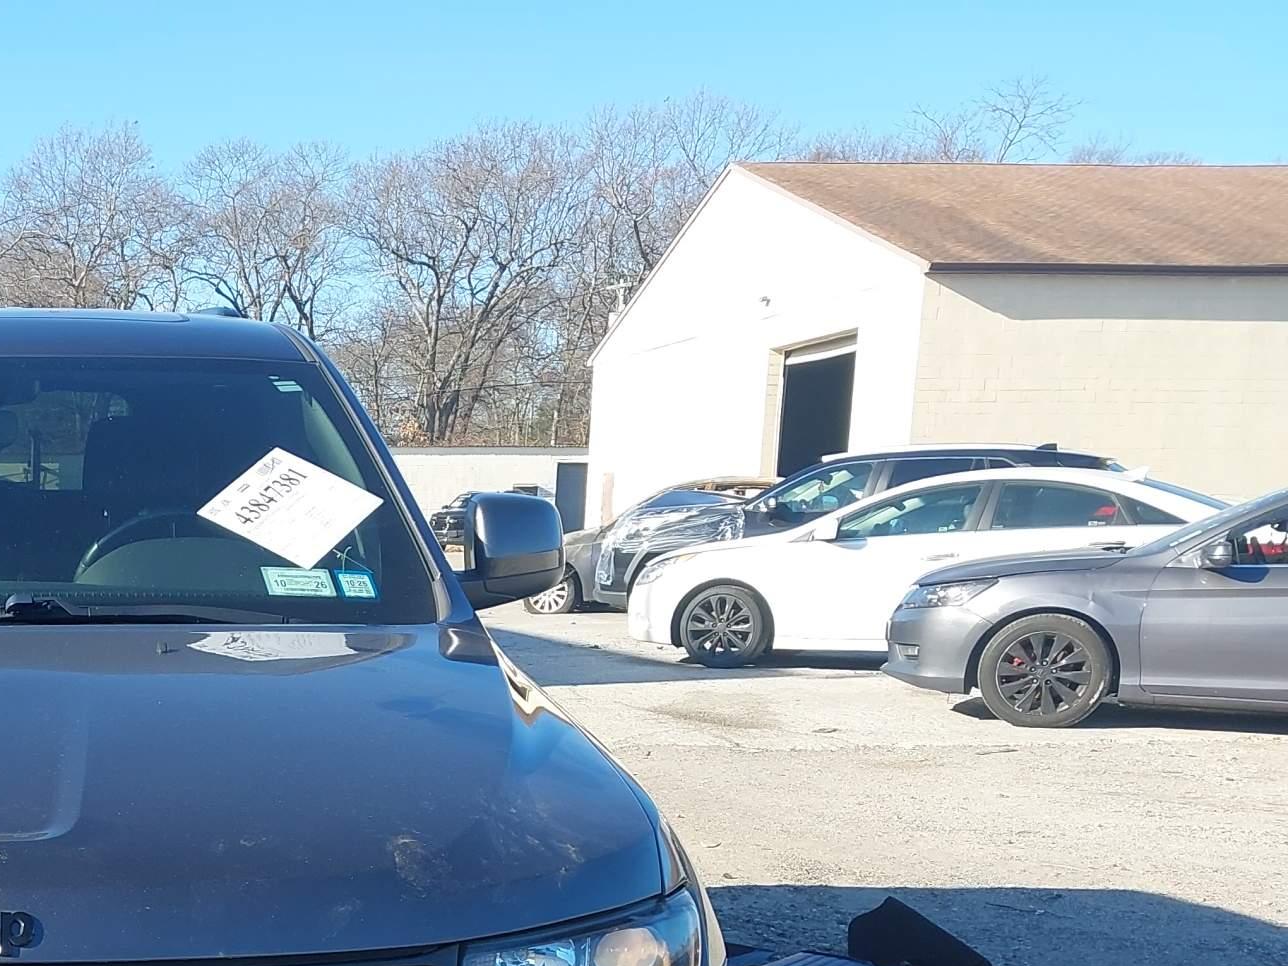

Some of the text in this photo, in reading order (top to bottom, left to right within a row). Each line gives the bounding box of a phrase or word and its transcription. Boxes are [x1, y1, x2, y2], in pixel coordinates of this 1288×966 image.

[234, 467, 309, 526] 43847381
[273, 579, 287, 589] 10
[313, 580, 328, 590] 26
